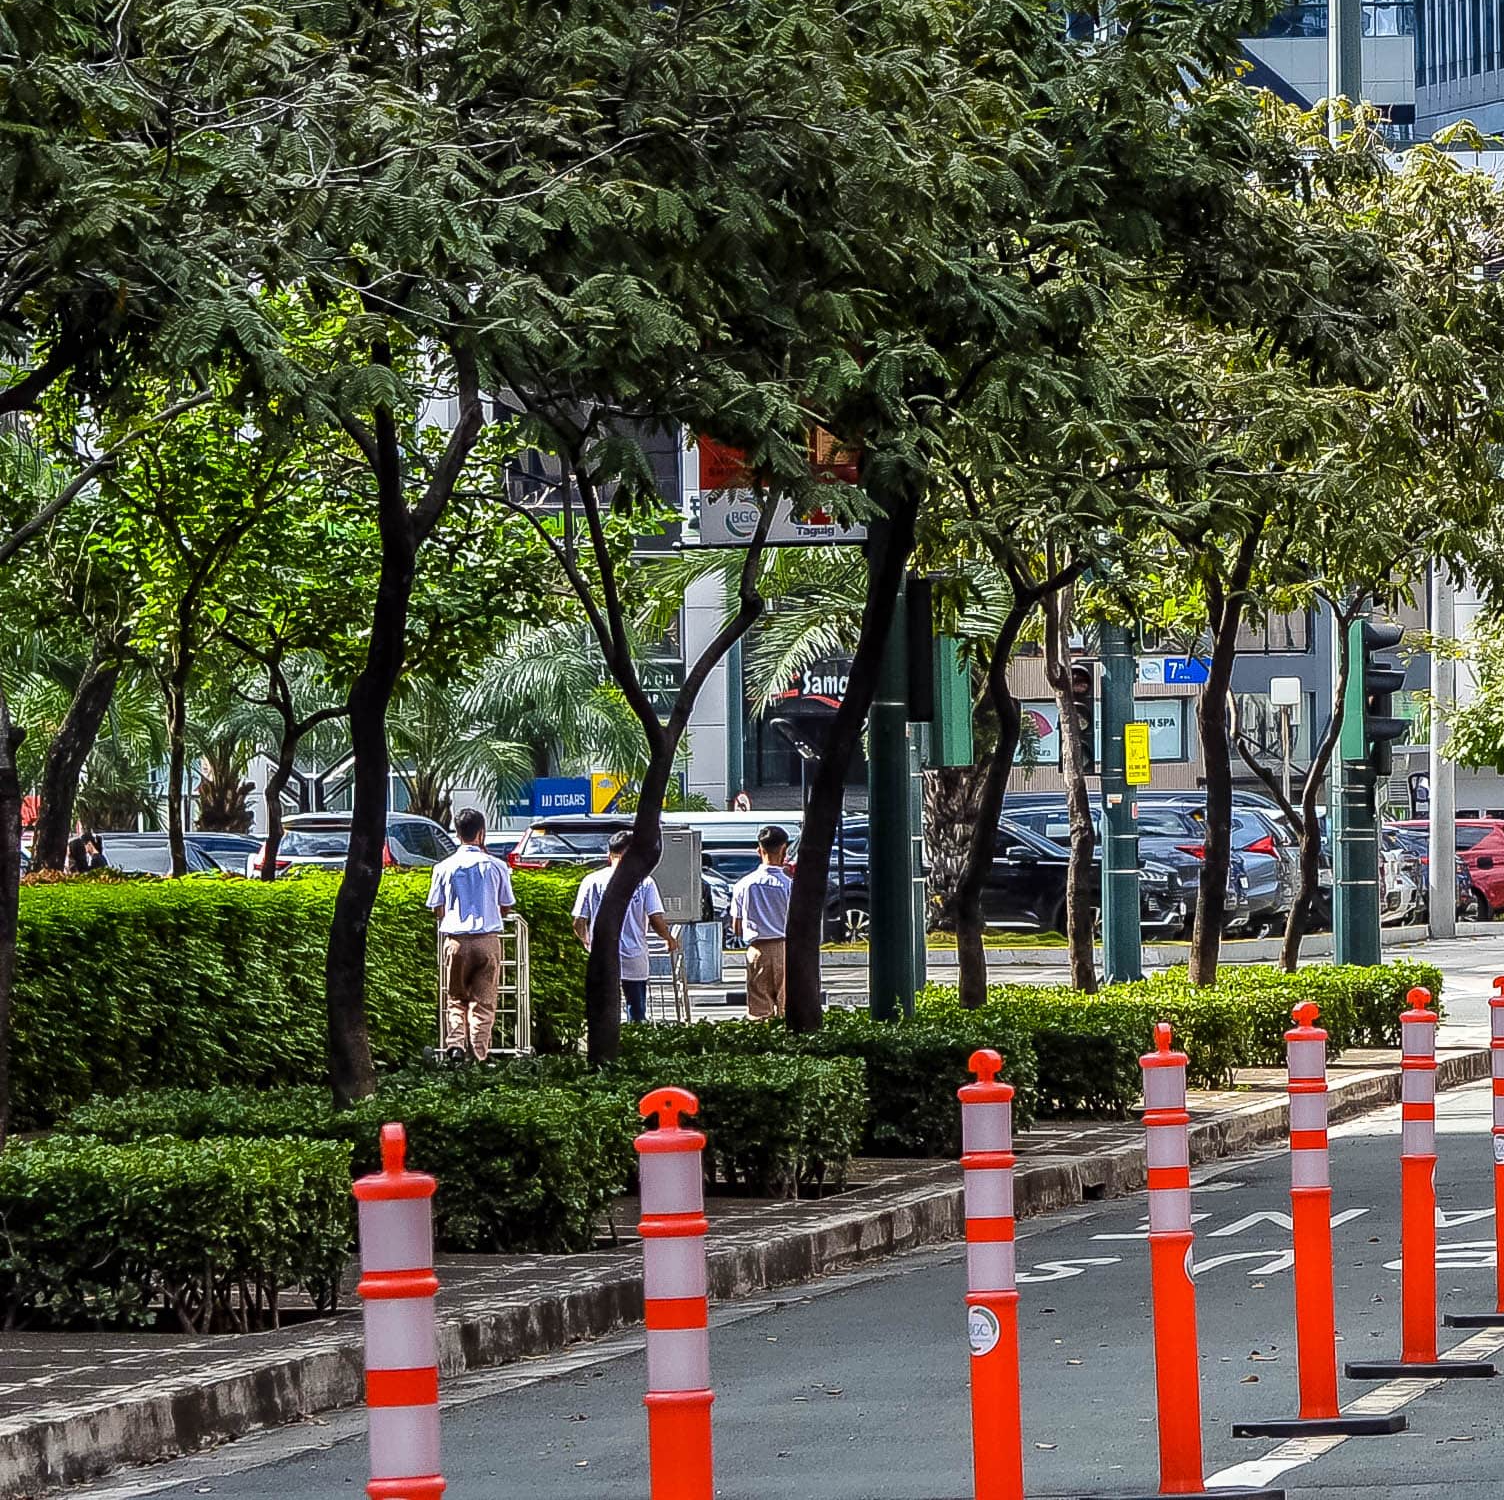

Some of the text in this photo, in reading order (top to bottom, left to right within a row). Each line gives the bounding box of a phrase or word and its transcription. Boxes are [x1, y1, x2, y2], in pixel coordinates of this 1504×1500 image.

[795, 526, 835, 537] Taguig
[1156, 717, 1176, 728] SPA
[554, 793, 586, 807] CIGARS
